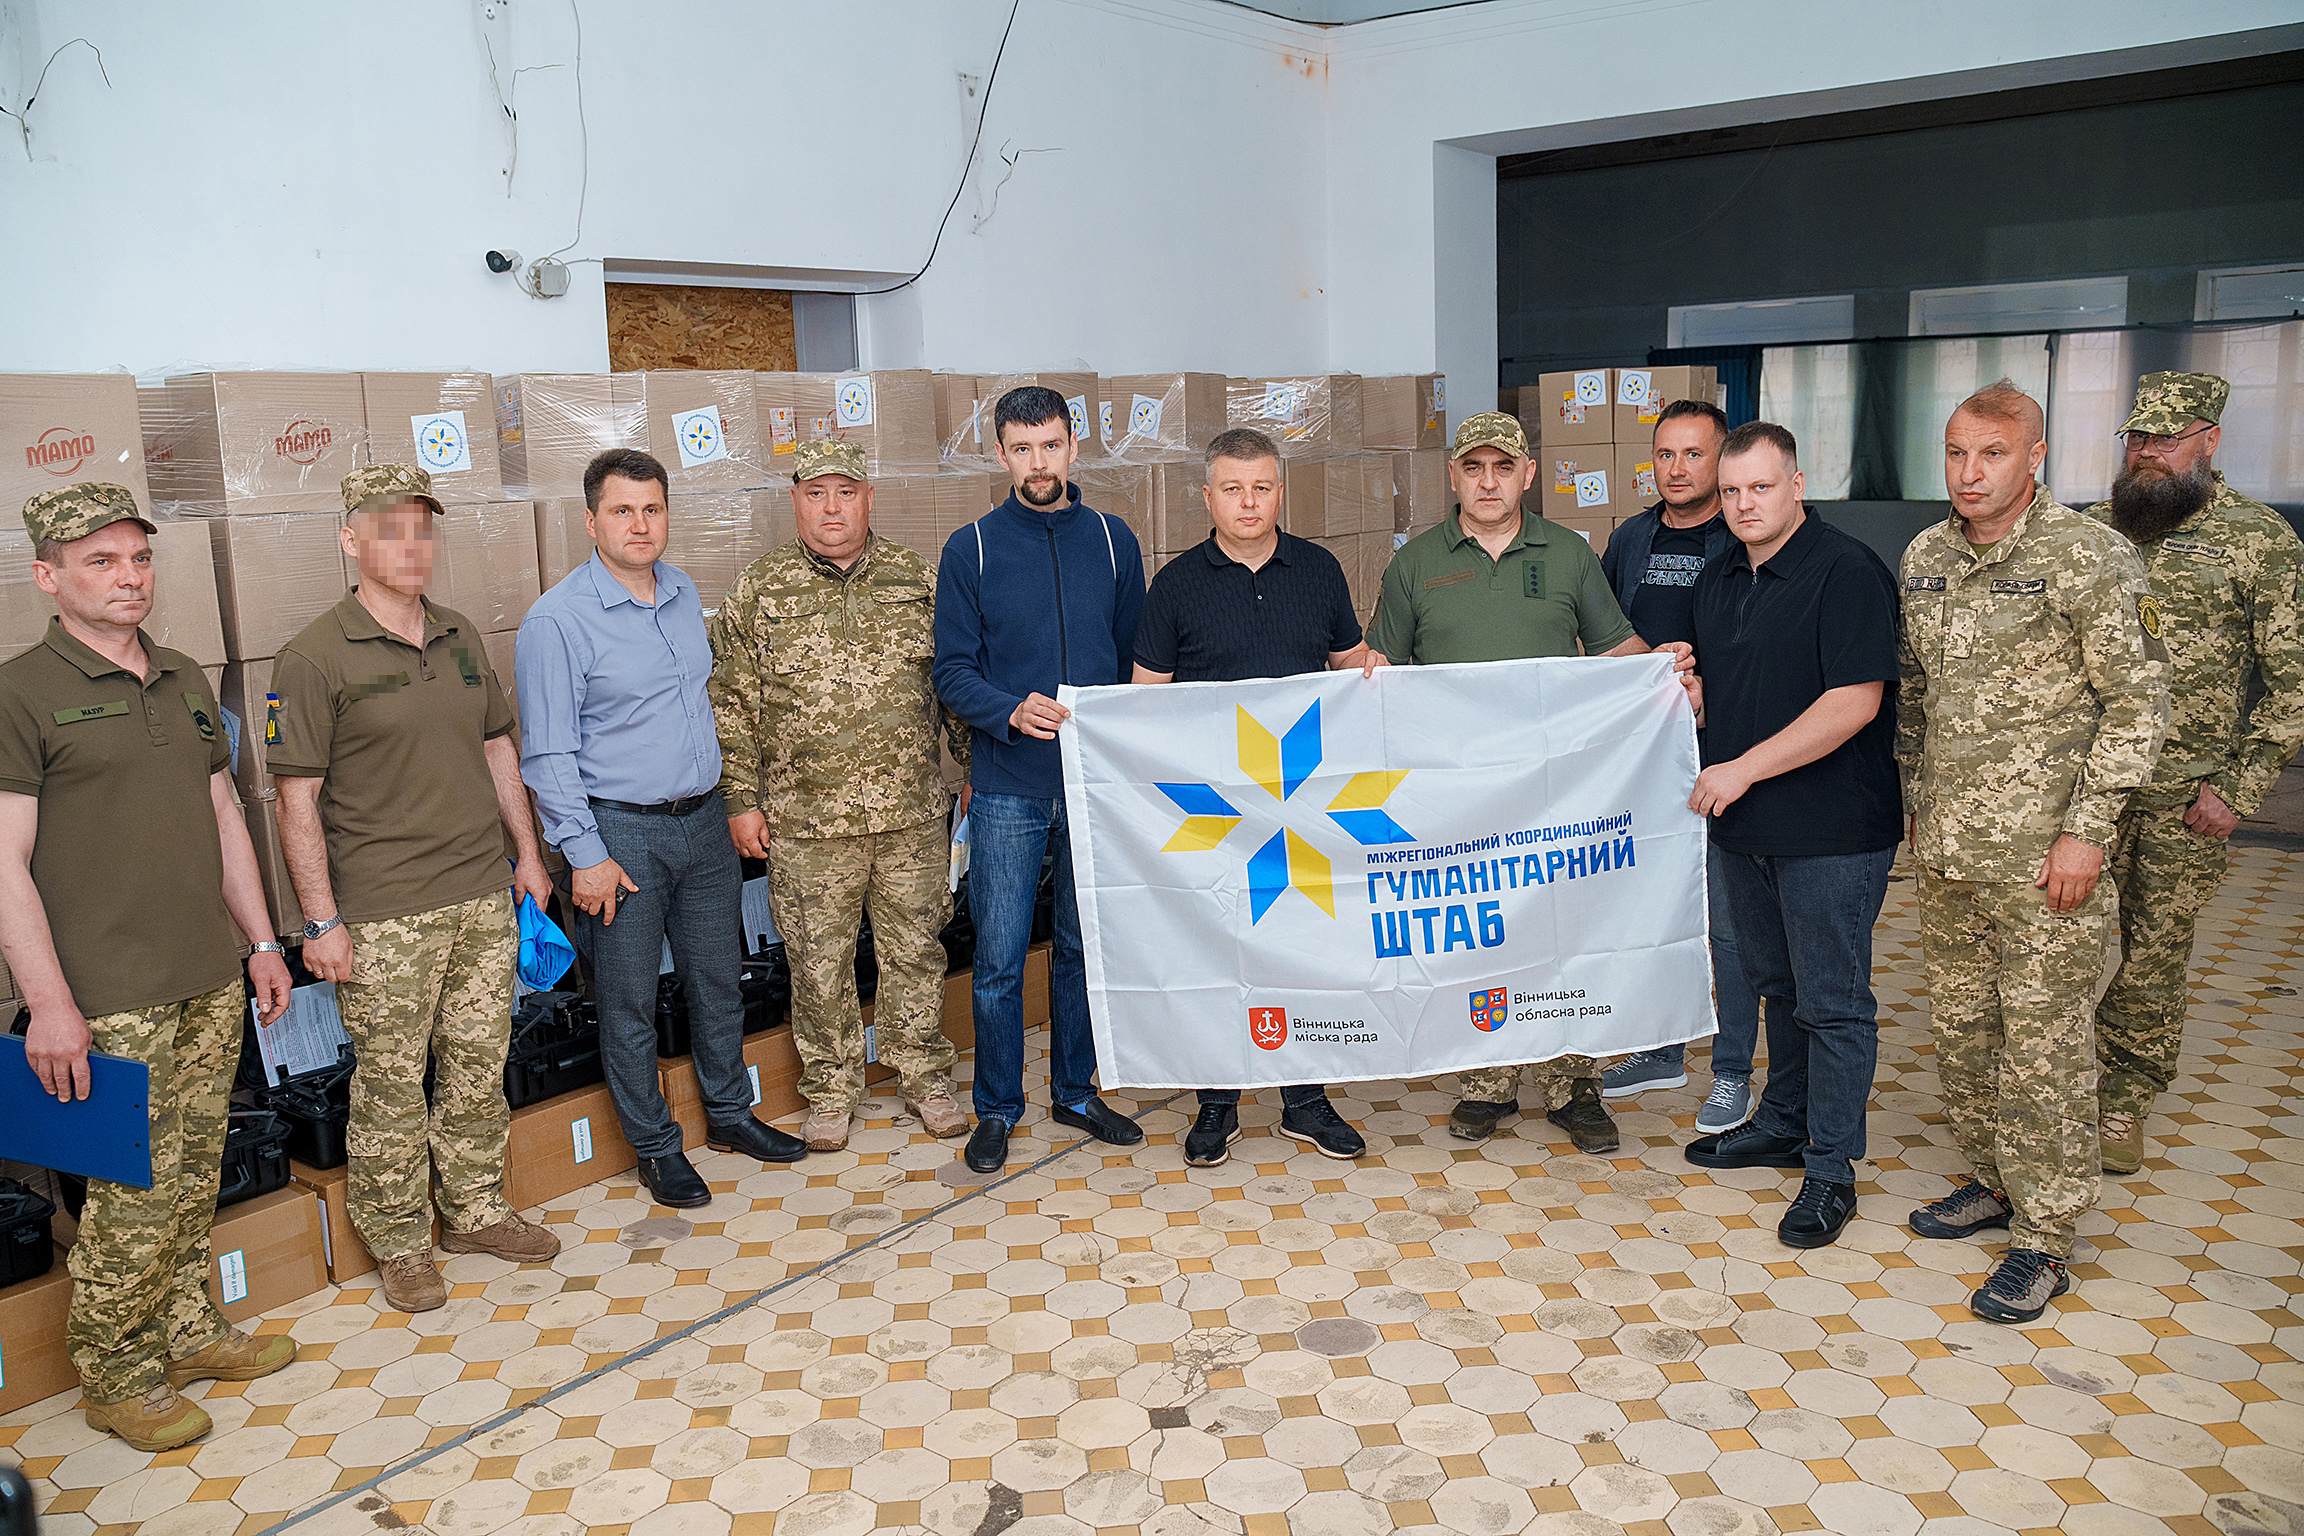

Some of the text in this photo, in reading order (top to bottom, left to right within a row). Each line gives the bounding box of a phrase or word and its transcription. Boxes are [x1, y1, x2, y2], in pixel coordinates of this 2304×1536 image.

[1367, 810, 1633, 864] МІЖРЕГІОНАЛЬНИЙ КООРДИНАЦІЙНИЙ
[1366, 828, 1637, 905] ГУМАНІТАРНИЙ
[1371, 899, 1506, 959] ШТАБ
[1514, 988, 1586, 1005] Вінницька
[1515, 1004, 1612, 1022] обласна рада
[1293, 1018, 1365, 1030] Вінницька
[1295, 1031, 1378, 1045] міська рада
